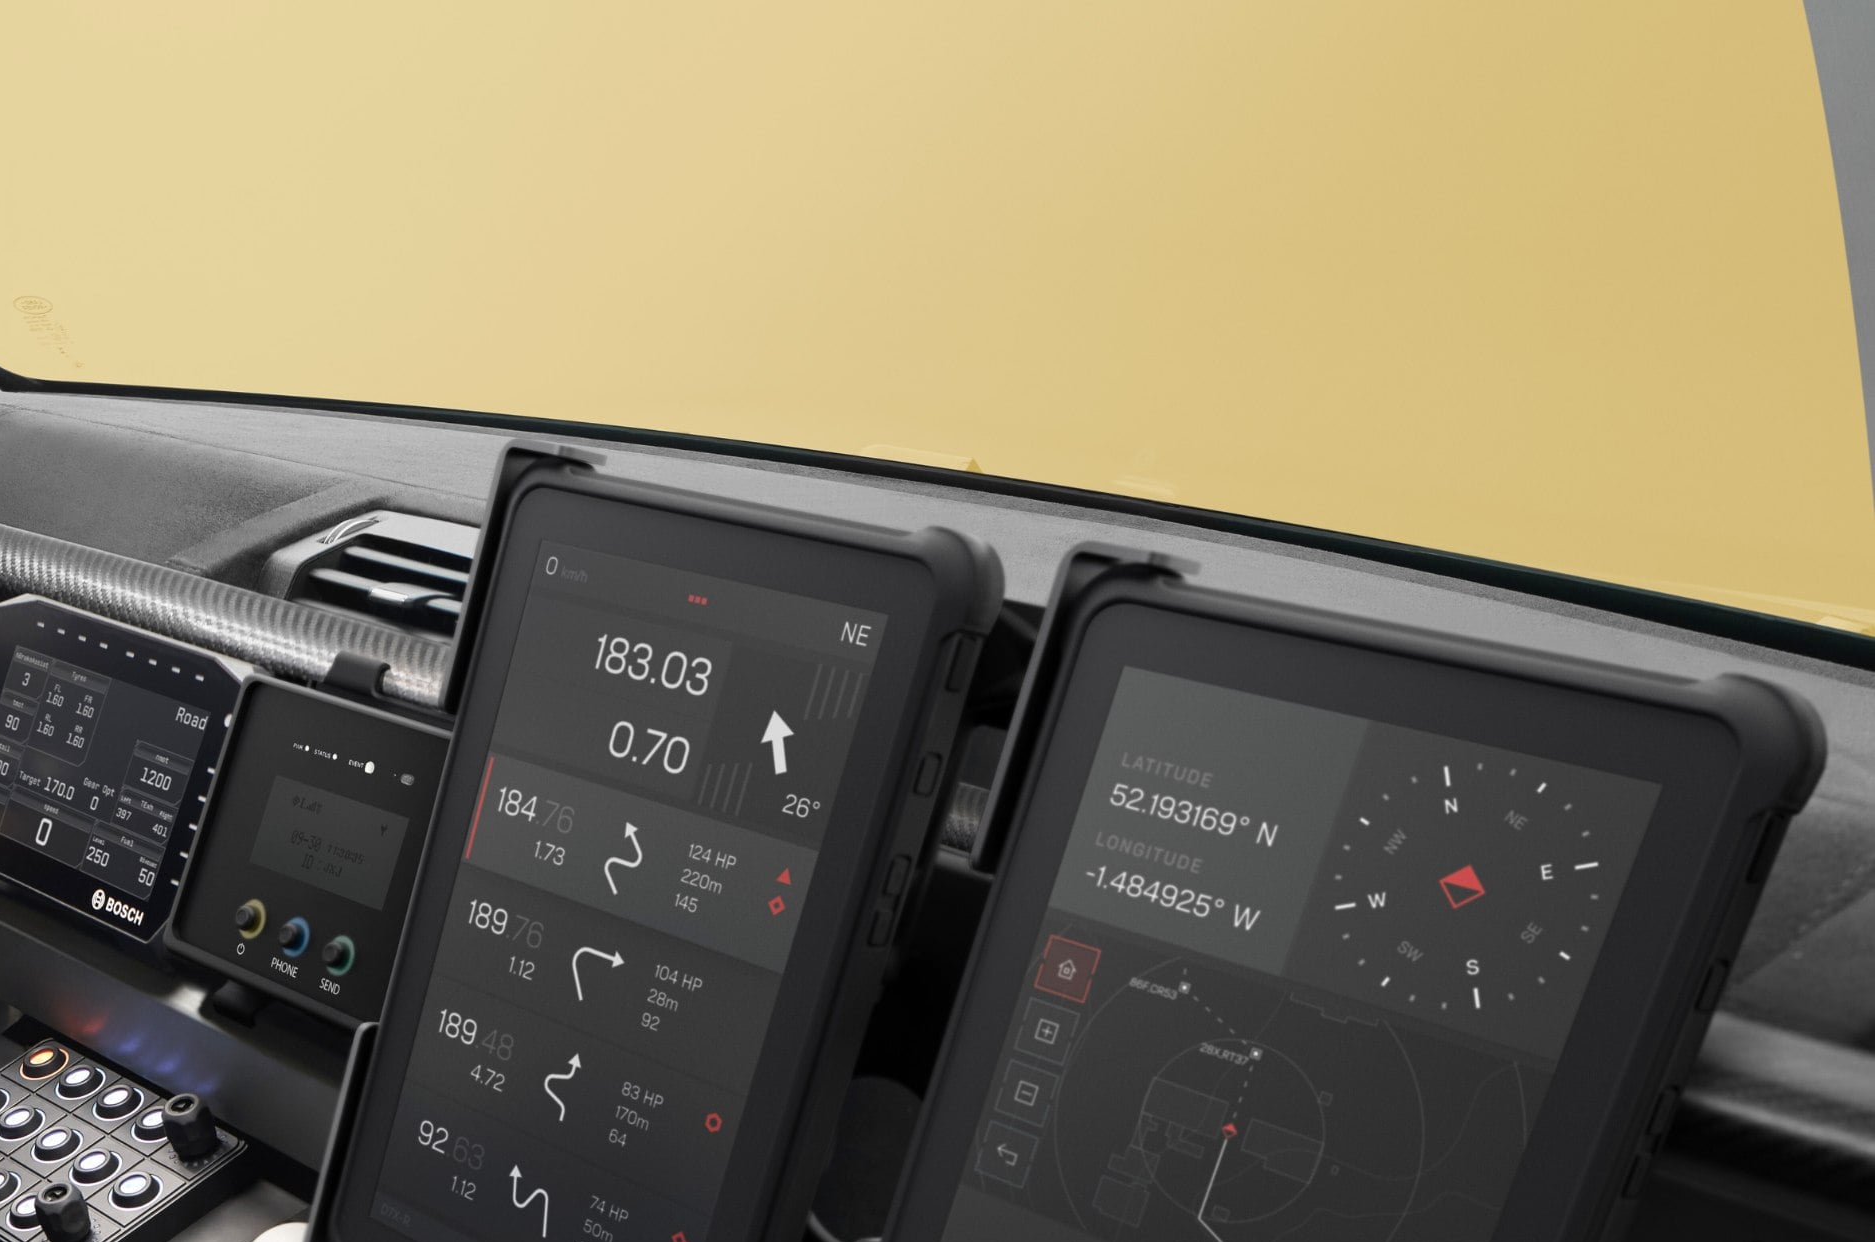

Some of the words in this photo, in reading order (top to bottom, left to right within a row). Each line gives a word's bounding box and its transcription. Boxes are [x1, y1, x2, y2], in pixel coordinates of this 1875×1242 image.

[546, 556, 558, 575] 0
[840, 621, 872, 647] NE
[593, 634, 713, 696] 183.03
[22, 672, 31, 687] 3
[54, 684, 62, 693] FL
[46, 692, 65, 707] 1.60
[76, 703, 95, 718] 1.60
[84, 694, 93, 704] FR
[5, 714, 20, 731] 90
[36, 721, 55, 737] 1.60
[75, 725, 83, 734] RR
[175, 706, 210, 730] Road
[66, 733, 85, 748] 1.60
[608, 720, 691, 774] 0.70
[140, 767, 172, 791] 1200
[1121, 752, 1213, 788] LATITUDE
[19, 771, 41, 786] Target
[44, 777, 75, 800] 170.0
[83, 777, 99, 790] Gear
[102, 784, 115, 797] Opt
[90, 796, 99, 811] 0
[116, 807, 132, 821] 397
[497, 786, 576, 835] 184.76
[781, 793, 821, 819] 26°
[1109, 783, 1250, 835] 52.193169°
[1256, 821, 1279, 847] N
[1444, 798, 1458, 814] N
[152, 823, 168, 838] 401
[1504, 809, 1528, 831] NE
[35, 818, 52, 846] 0
[120, 836, 134, 848] Fuel
[1383, 829, 1407, 855] NW
[86, 846, 110, 868] 250
[533, 840, 567, 867] 1.73
[688, 843, 711, 863] 124
[713, 850, 737, 871] HP
[1095, 831, 1203, 874] LONGITUDE
[138, 868, 155, 887] 50
[680, 868, 723, 895] 220m
[1540, 864, 1553, 880] E
[674, 893, 698, 914] 145
[1086, 865, 1225, 917] -1.484925°
[1233, 903, 1261, 931] W
[1367, 892, 1386, 909] W
[105, 897, 144, 926] BOSCH
[467, 898, 545, 948] 189.76
[1520, 921, 1543, 944] SE
[1397, 940, 1423, 962] SW
[271, 957, 298, 978] PHONE
[508, 955, 536, 981] 1.12
[654, 964, 678, 984] 104
[681, 971, 703, 992] HP
[1466, 959, 1480, 975] S
[319, 978, 340, 995] SEND
[646, 989, 679, 1012] 28m
[640, 1012, 661, 1032] 92
[437, 1008, 515, 1061] 189.48
[470, 1063, 506, 1093] 4.72
[620, 1081, 642, 1101] 83
[644, 1089, 665, 1109] HP
[615, 1105, 650, 1132] 170m
[417, 1119, 486, 1172] 92.63
[608, 1128, 628, 1148] 64
[451, 1175, 477, 1202] 1.12
[588, 1195, 607, 1216] 74
[608, 1202, 630, 1223] HP
